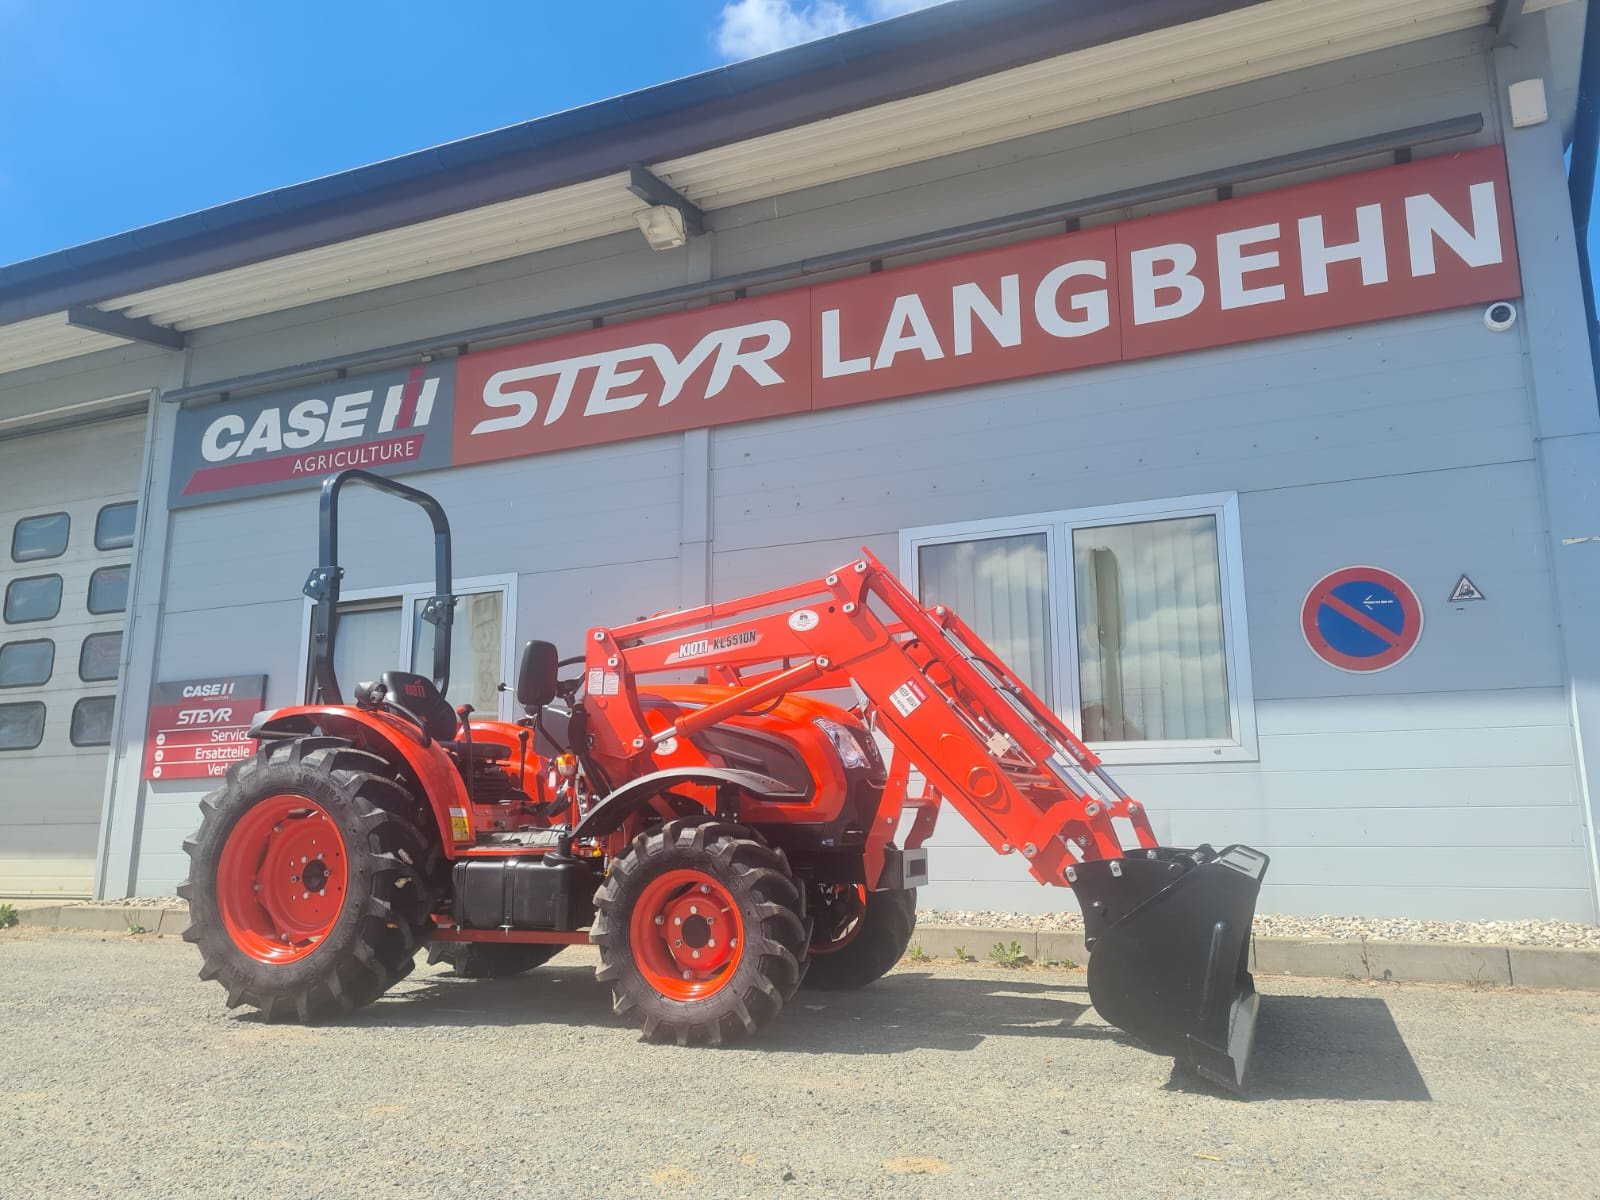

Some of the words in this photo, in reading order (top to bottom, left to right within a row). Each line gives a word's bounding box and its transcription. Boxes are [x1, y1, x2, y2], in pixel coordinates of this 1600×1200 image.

[822, 182, 1502, 378] LANGBEHN
[471, 320, 791, 435] STEYR
[202, 390, 374, 462] CASE
[292, 440, 414, 474] AGRICULTURE
[183, 684, 221, 698] CASE
[176, 707, 232, 725] STEYR
[195, 745, 250, 760] Ersatzteile
